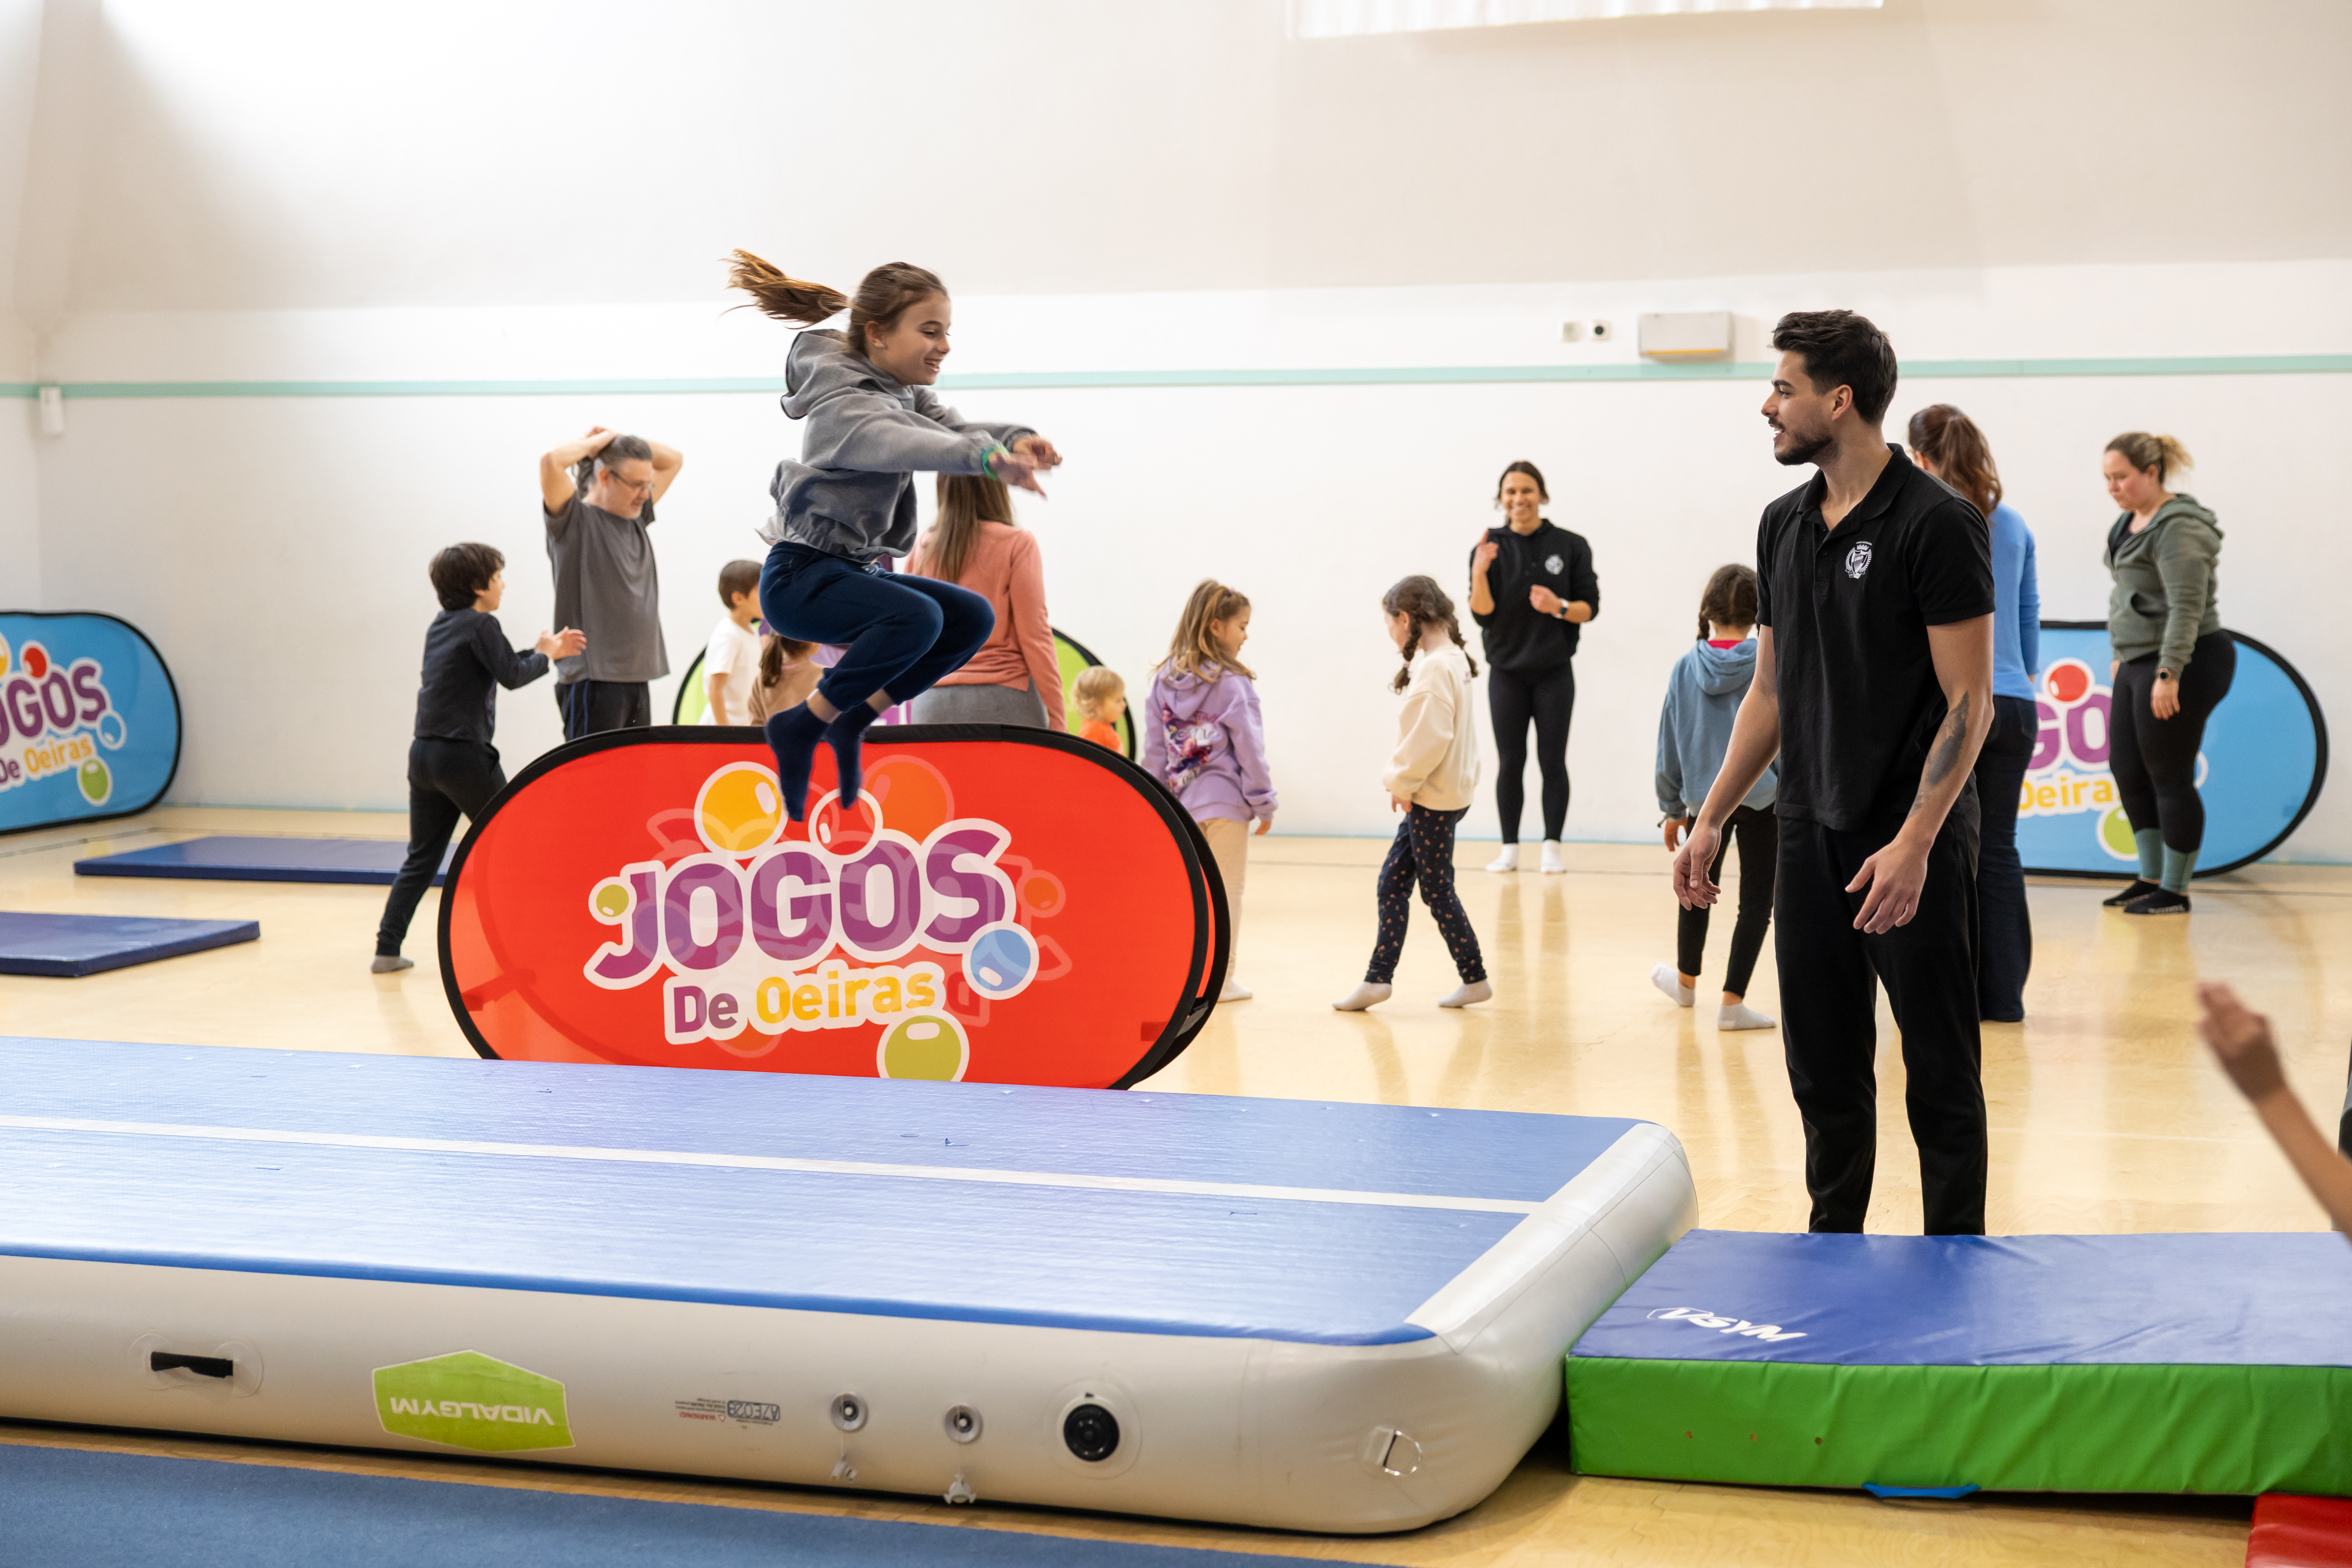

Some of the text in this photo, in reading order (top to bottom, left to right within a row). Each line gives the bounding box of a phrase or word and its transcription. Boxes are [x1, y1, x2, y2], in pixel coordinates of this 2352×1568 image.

[0, 665, 107, 746] GOS
[24, 738, 92, 773] Oeiras
[2019, 776, 2120, 810] Oeira
[594, 830, 1006, 978] JOGOS
[673, 971, 936, 1033] De Oeiras
[390, 1397, 554, 1425] VIDALGYM
